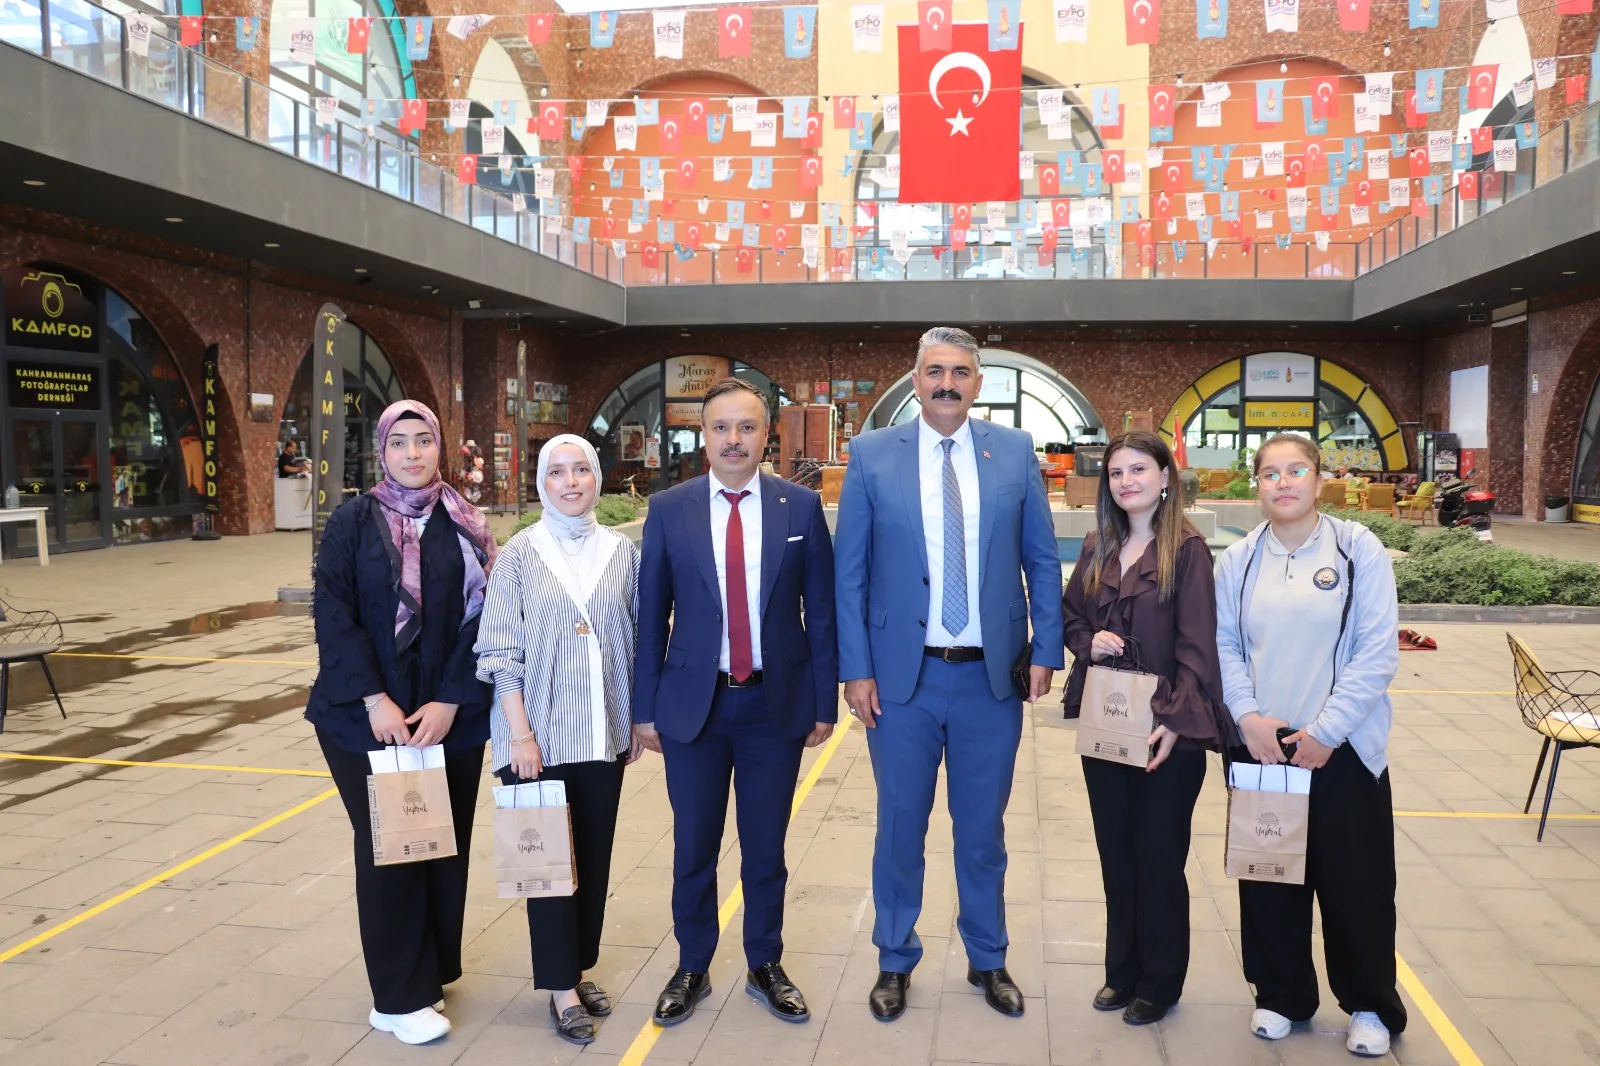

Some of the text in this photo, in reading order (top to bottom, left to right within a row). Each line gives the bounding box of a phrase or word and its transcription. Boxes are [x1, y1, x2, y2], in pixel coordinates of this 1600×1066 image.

[1058, 5, 1084, 18] EXPO
[855, 15, 880, 28] EXPO
[657, 22, 680, 34] EXPO
[1061, 111, 1070, 120] PO
[1357, 106, 1367, 114] EX
[1431, 136, 1450, 145] EXPO
[1265, 150, 1282, 158] EXPO
[1496, 147, 1514, 156] EXPO
[1370, 155, 1388, 163] EXPO
[12, 318, 92, 338] KAMFOD
[16, 369, 92, 382] KAHRAMANMARAŞ
[678, 362, 716, 378] Maraş
[20, 381, 89, 392] FOTOĞRAFÇILAR
[38, 393, 75, 402] DERNEĞİ
[319, 340, 334, 505] KAMFOD
[205, 379, 217, 497] KAMFOD
